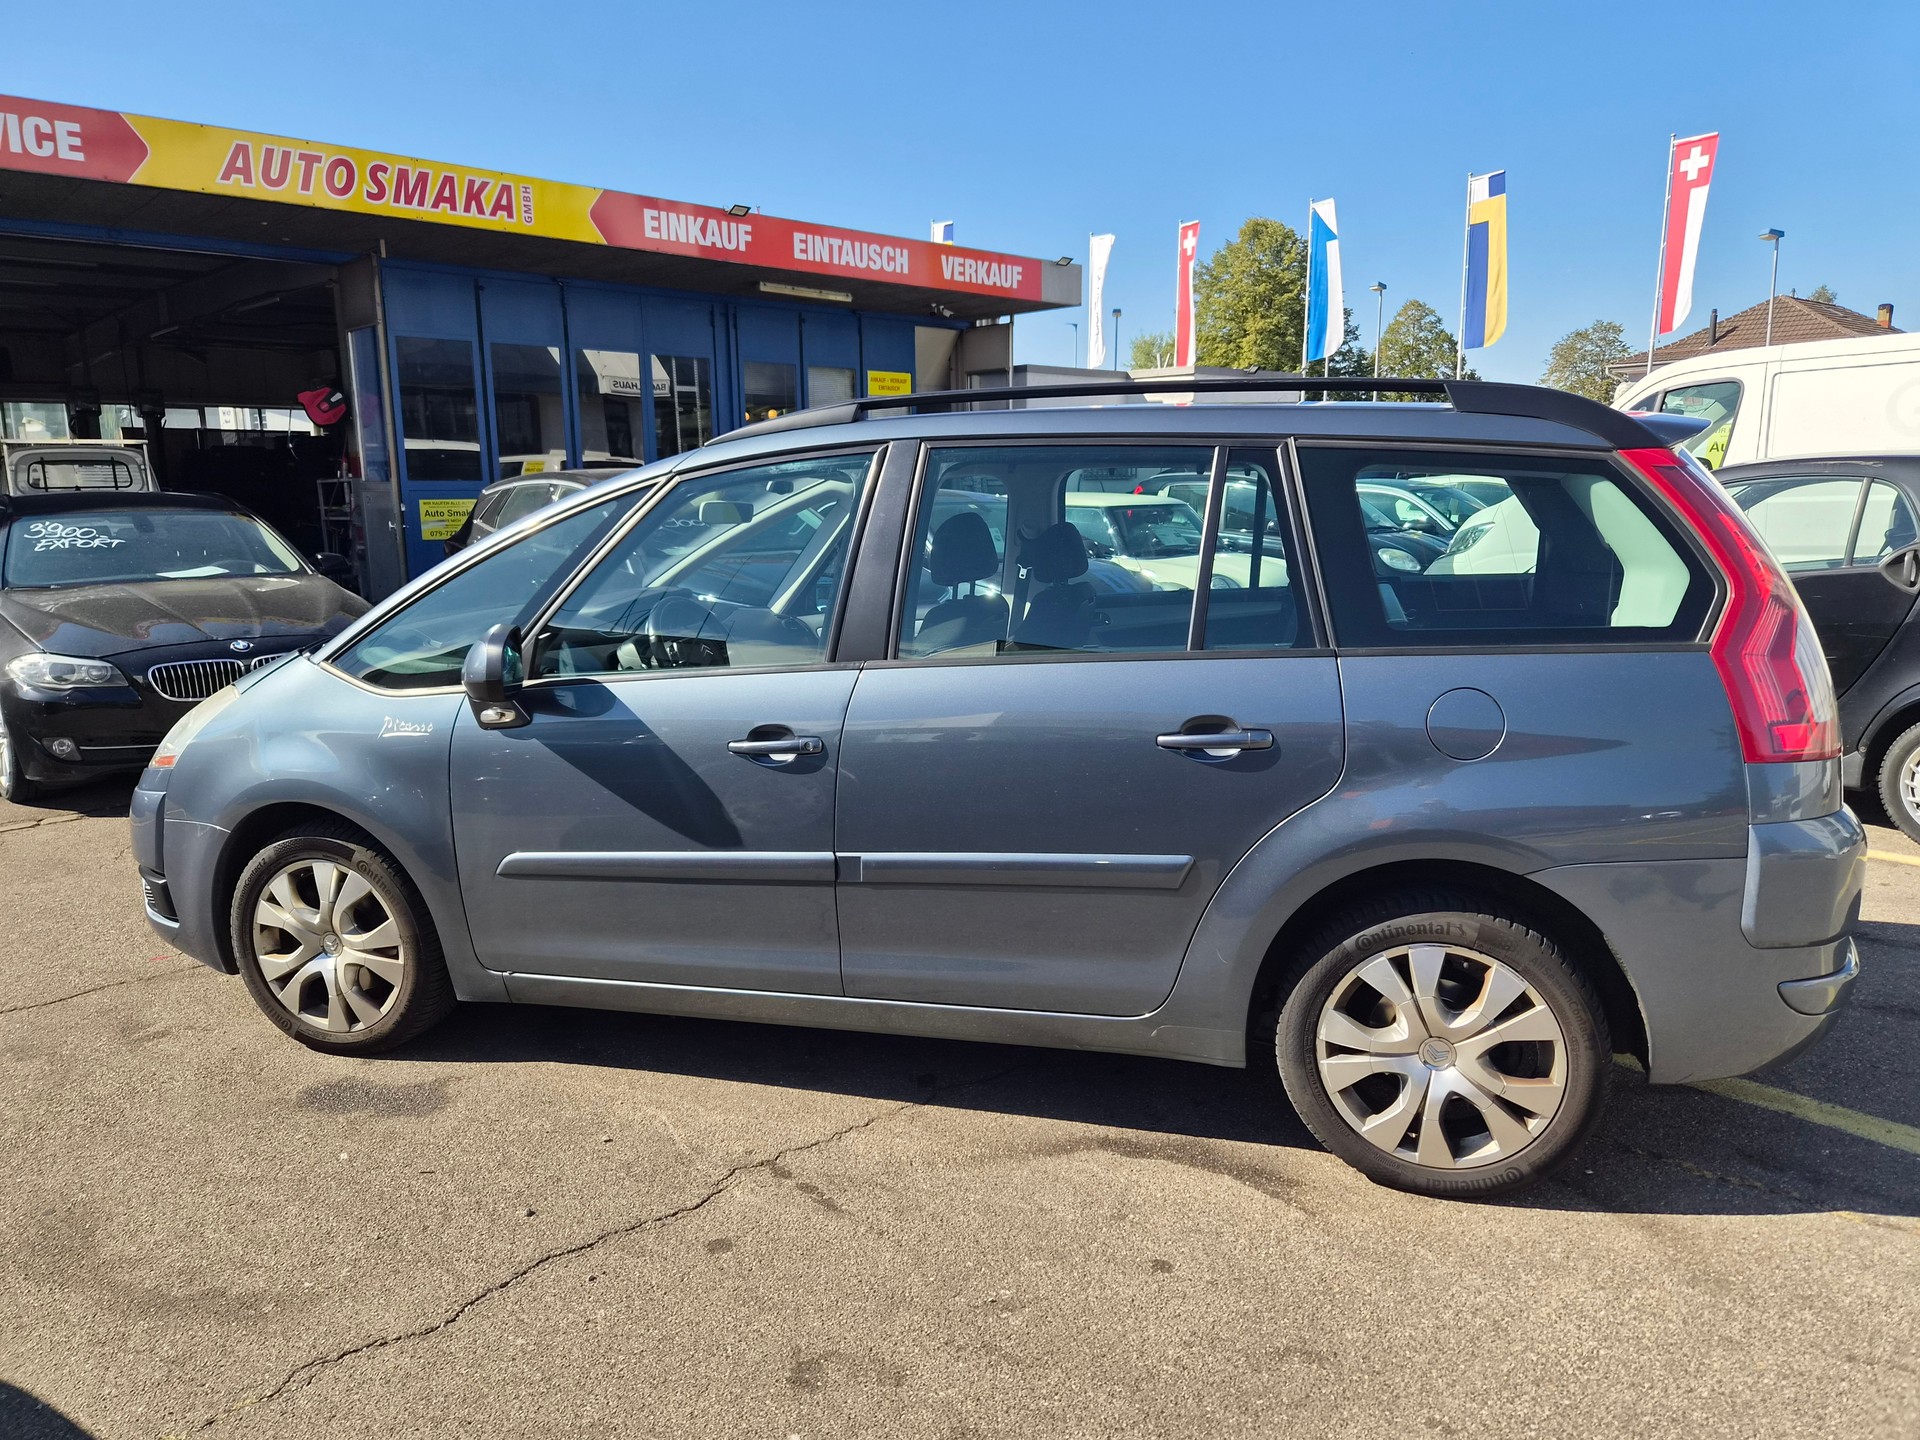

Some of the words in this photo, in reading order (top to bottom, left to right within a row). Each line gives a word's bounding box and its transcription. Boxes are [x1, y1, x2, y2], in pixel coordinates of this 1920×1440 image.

[218, 141, 357, 199] AUTO
[363, 161, 517, 222] SMAKA
[522, 184, 533, 225] GMBH
[643, 208, 752, 252] EINKAUF
[793, 232, 909, 274] EINTAUSCH
[941, 254, 1022, 289] VERKAUF
[424, 509, 445, 518] Auto
[34, 537, 126, 552] EXPORT
[1355, 921, 1450, 950] Continental
